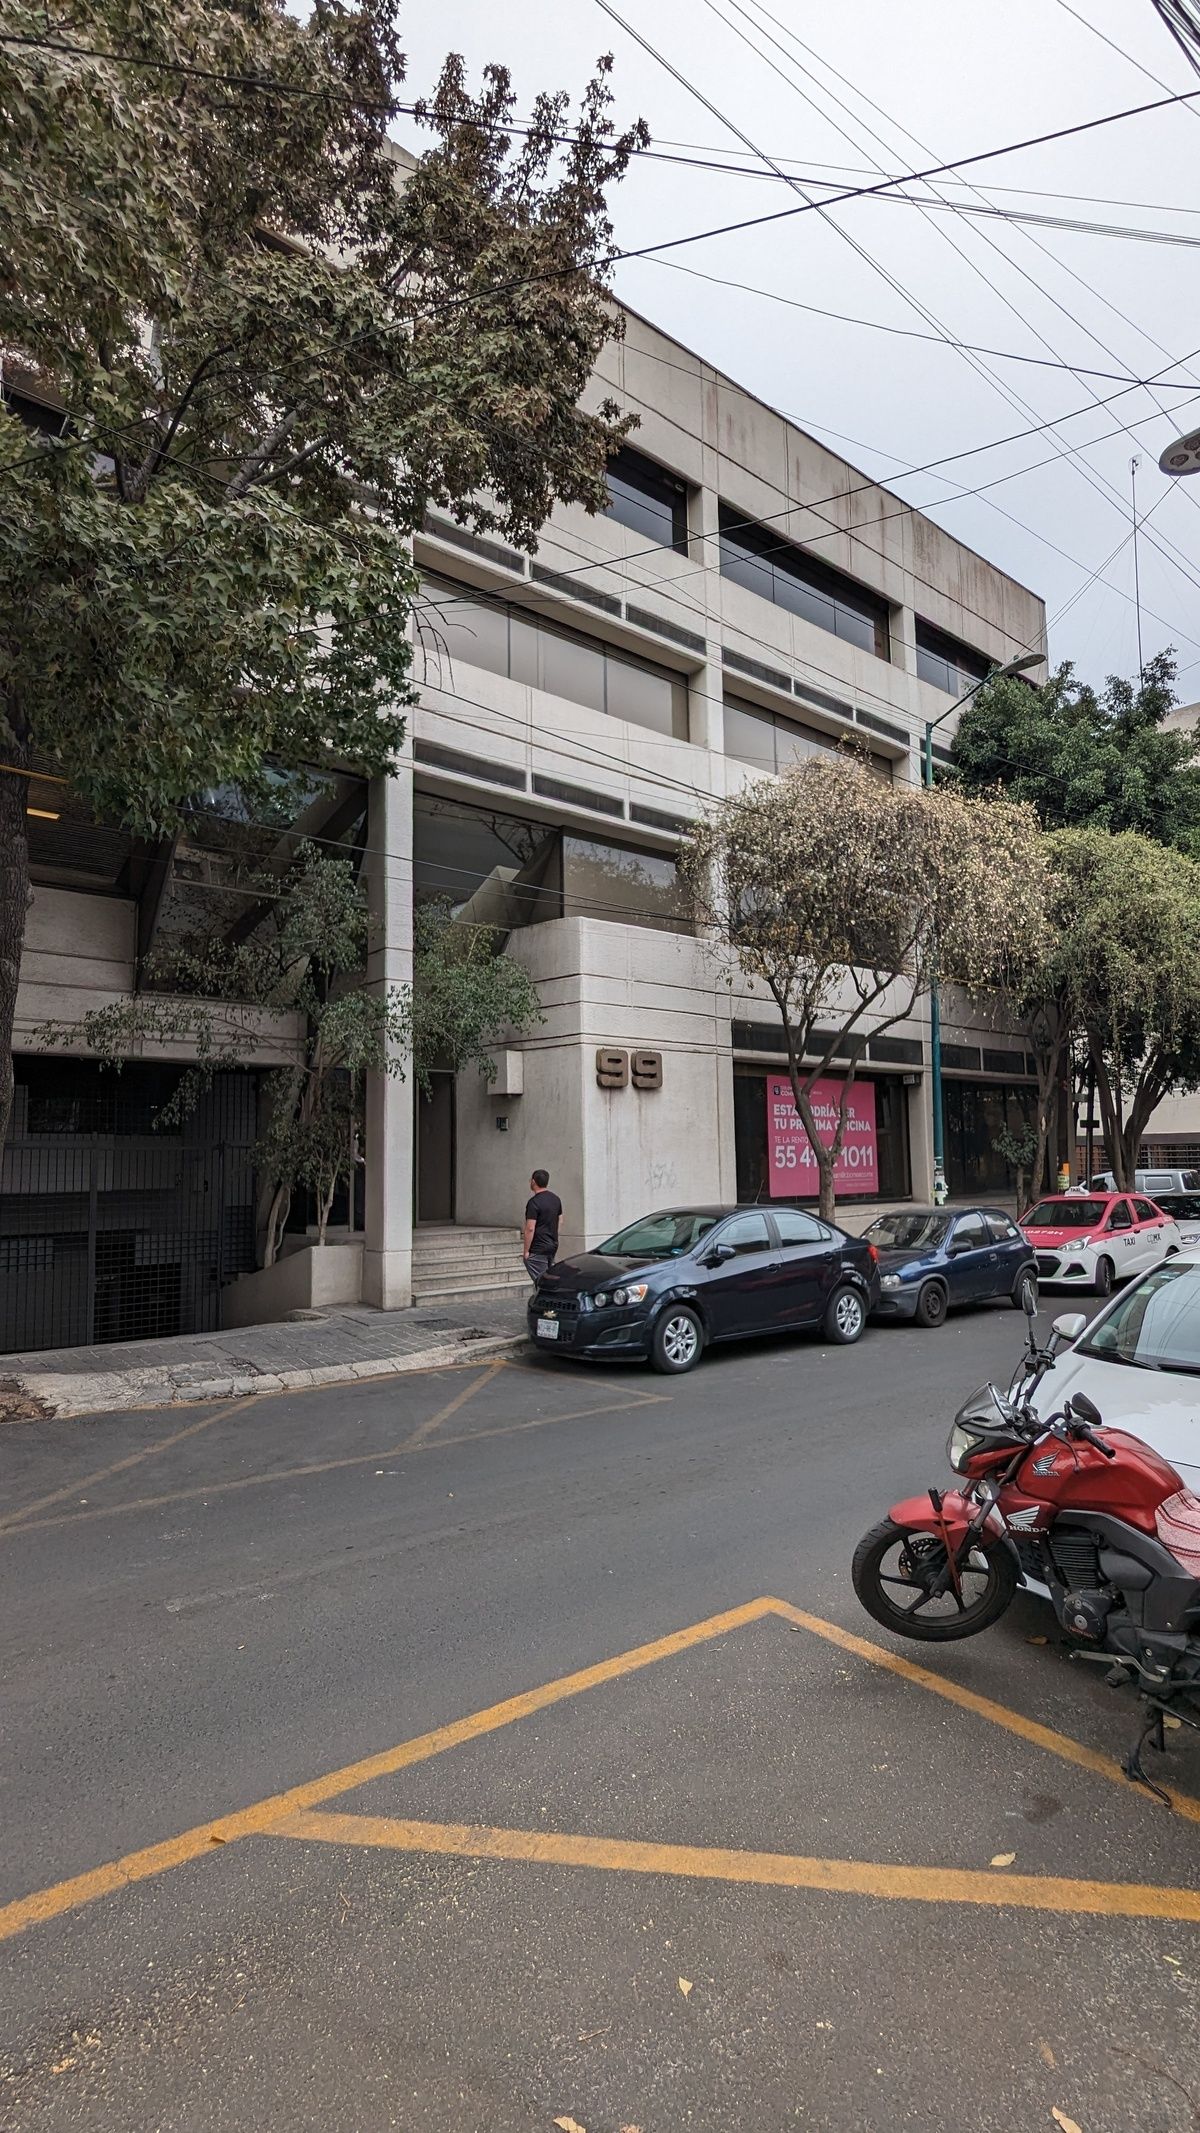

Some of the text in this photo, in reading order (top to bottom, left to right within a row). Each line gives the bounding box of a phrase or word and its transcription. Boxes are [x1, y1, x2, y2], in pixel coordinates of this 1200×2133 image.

[596, 1048, 663, 1089] 99
[774, 1104, 799, 1116] ESTA
[803, 1104, 836, 1118] DRÍA
[774, 1118, 871, 1132] TU PRIMA OICINA
[775, 1145, 797, 1168] 55
[840, 1145, 873, 1168] 1011
[1123, 1236, 1136, 1246] TAXI
[1009, 1525, 1048, 1533] HONDA
